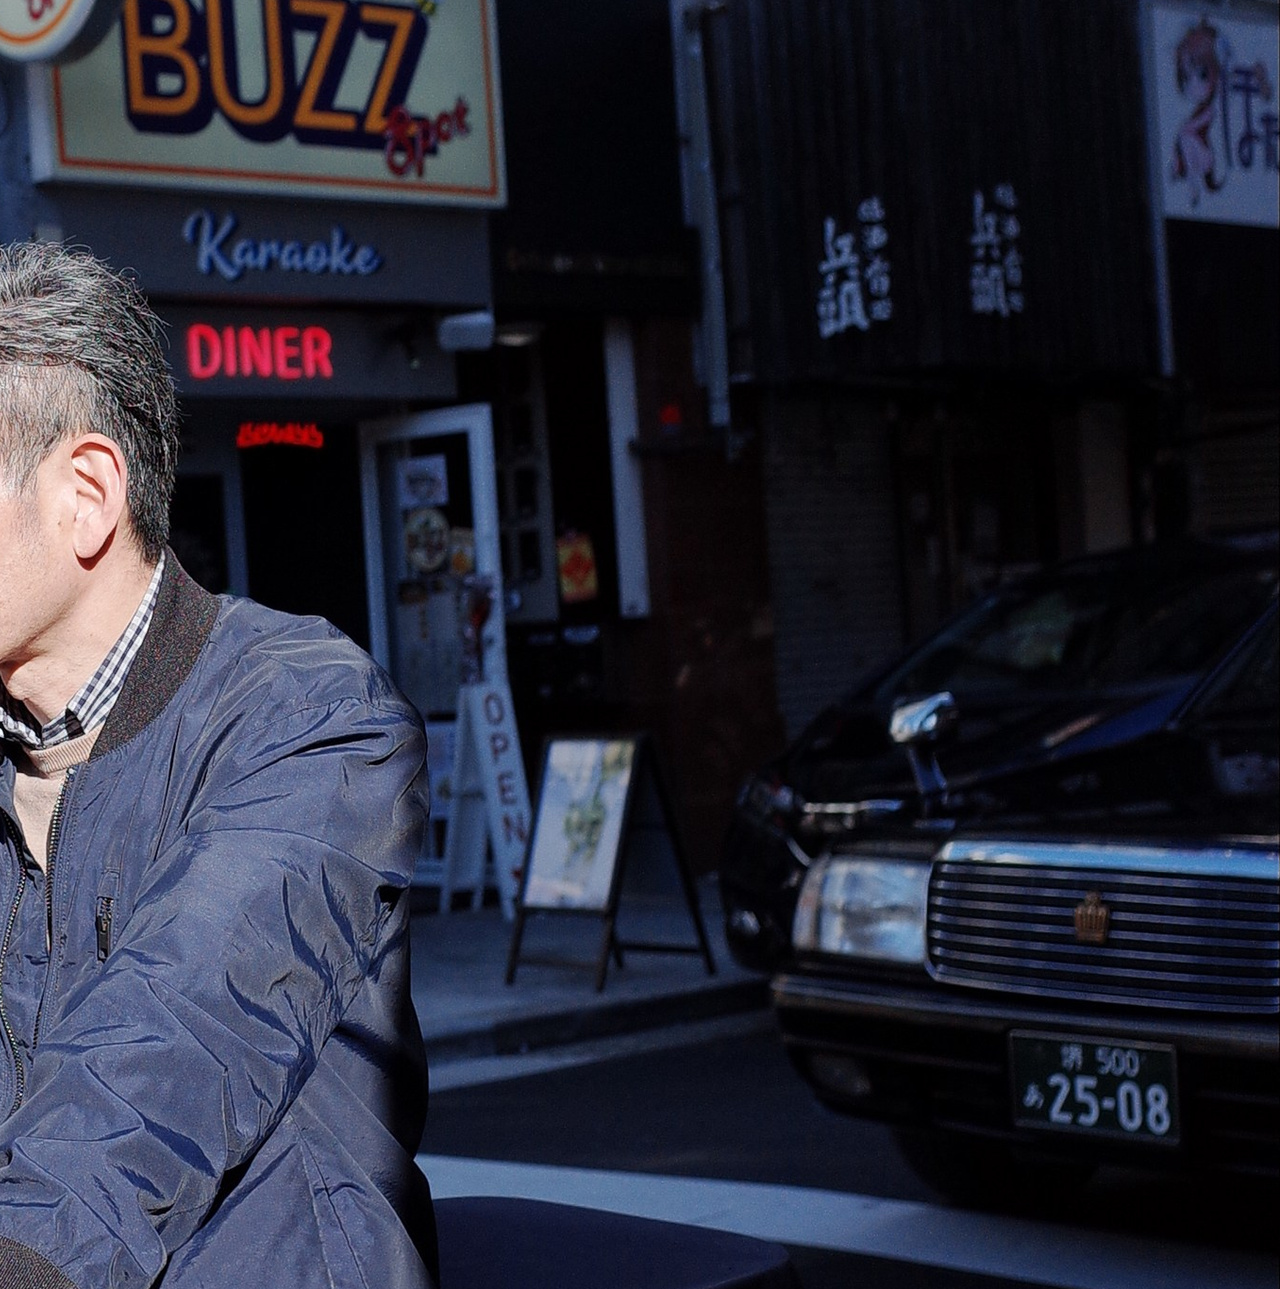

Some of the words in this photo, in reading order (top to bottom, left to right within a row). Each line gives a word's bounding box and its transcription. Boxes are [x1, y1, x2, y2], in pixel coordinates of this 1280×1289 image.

[382, 96, 472, 179] Spot
[183, 209, 384, 281] Karaoke
[185, 322, 334, 381] DINER
[483, 691, 528, 848] OPEN
[1095, 1046, 1141, 1079] 500
[1046, 1072, 1172, 1136] 25-08
